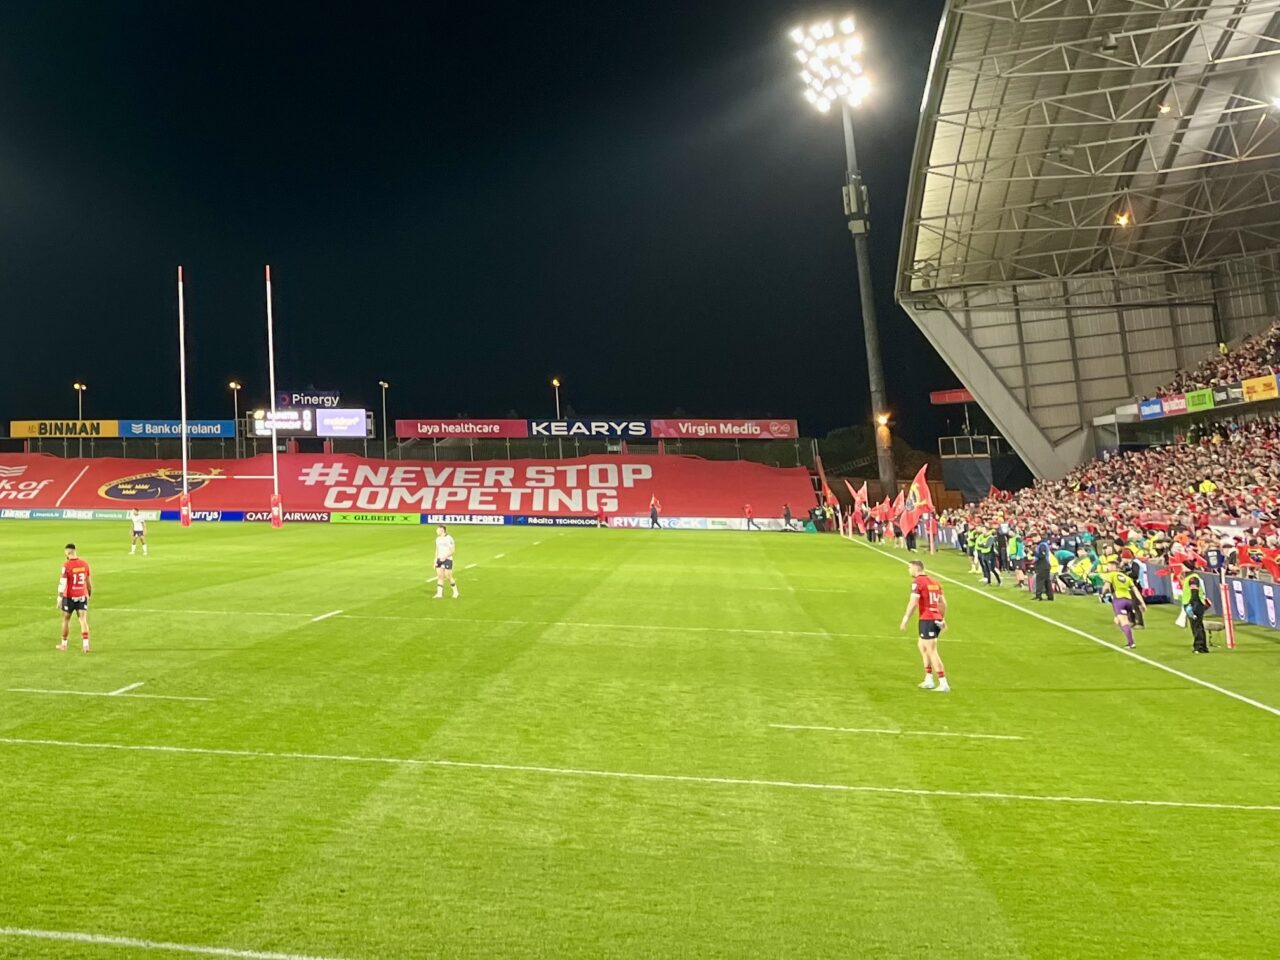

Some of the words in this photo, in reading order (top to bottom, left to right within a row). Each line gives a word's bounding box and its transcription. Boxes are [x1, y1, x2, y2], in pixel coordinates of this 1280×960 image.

[292, 393, 339, 406] Pinergy
[38, 422, 100, 436] BINMAN
[145, 424, 170, 434] Bank
[172, 424, 182, 434] of
[184, 424, 220, 434] reland
[417, 423, 439, 434] laya
[441, 423, 500, 433] healthcare
[532, 421, 646, 435] KEARYS
[678, 422, 717, 436] Virgin
[720, 423, 761, 435] Media
[298, 462, 514, 487] #NEVER
[525, 463, 653, 487] STOP
[18, 479, 54, 490] of
[323, 486, 619, 512] COMPETING
[190, 511, 219, 521] urrys
[246, 512, 275, 521] QATA
[284, 513, 329, 521] AIRWAYS
[428, 515, 443, 524] LIFE
[445, 515, 471, 524] STYLE
[473, 515, 504, 525] SPORTS
[73, 573, 85, 584] 13
[929, 592, 940, 604] 14
